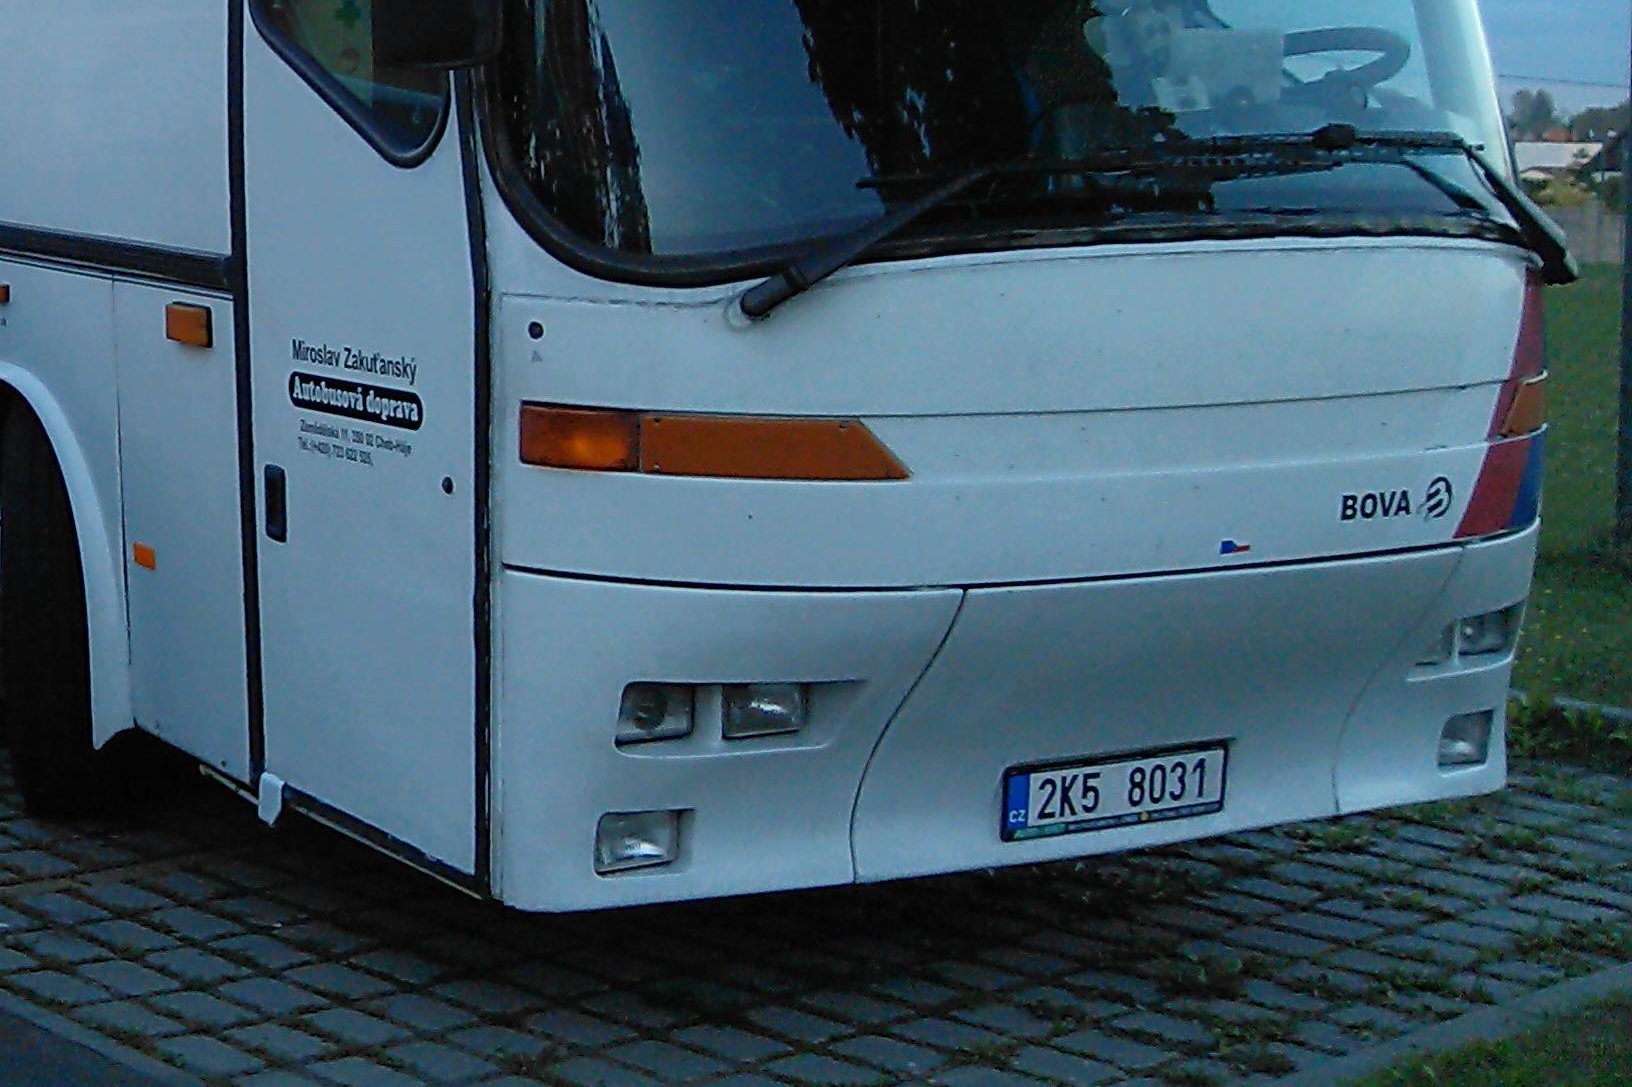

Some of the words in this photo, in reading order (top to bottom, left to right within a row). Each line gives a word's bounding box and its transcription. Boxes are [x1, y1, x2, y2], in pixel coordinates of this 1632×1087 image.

[291, 338, 341, 368] Miroslav
[343, 346, 417, 385] Zakuťanský
[293, 375, 364, 412] Autobusová
[366, 389, 419, 421] doprava
[1339, 489, 1411, 521] BOVA
[1037, 771, 1101, 820] 2K5
[1128, 756, 1207, 807] 8031
[1009, 809, 1026, 823] CZ
